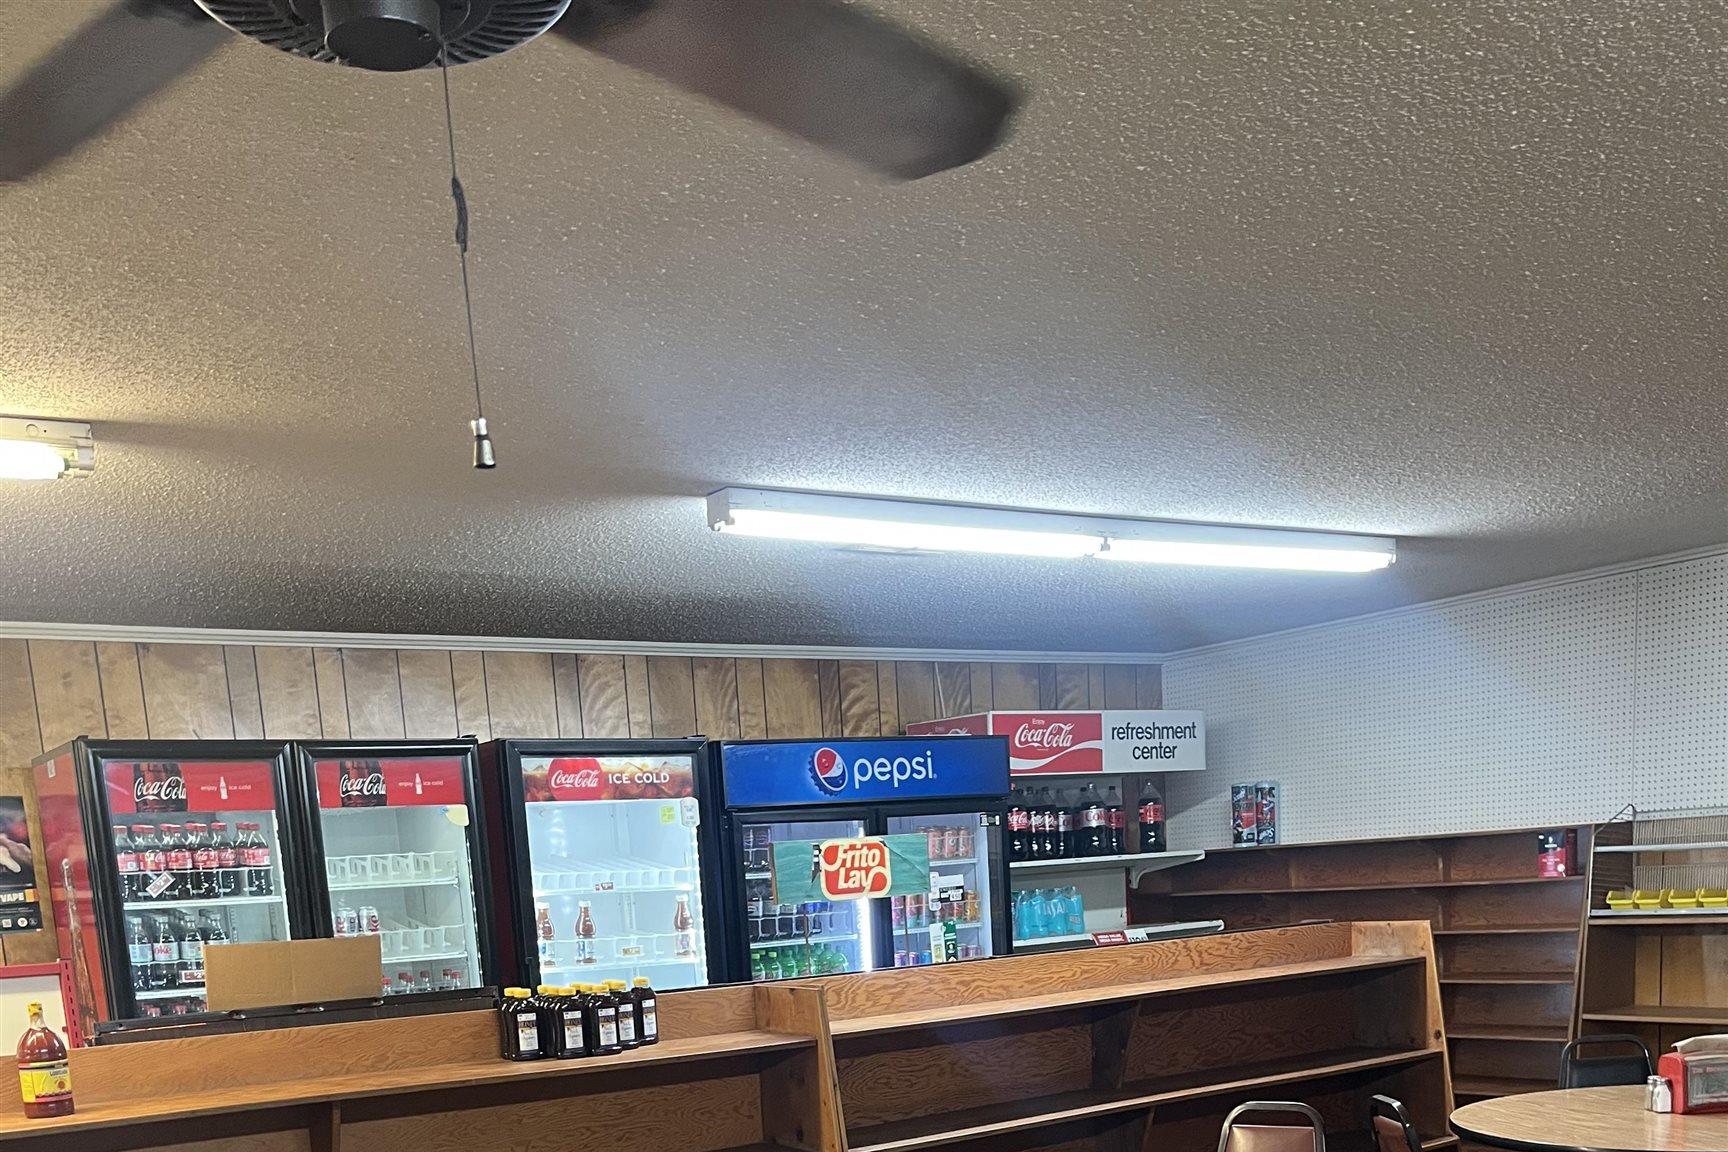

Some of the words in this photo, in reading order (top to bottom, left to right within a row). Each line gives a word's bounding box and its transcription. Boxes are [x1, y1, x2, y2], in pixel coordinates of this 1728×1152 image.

[1015, 723, 1075, 748] Coca-Cola
[1111, 721, 1197, 740] refreshment
[1132, 742, 1177, 760] center
[551, 769, 600, 788] Coca-Cola
[608, 773, 631, 785] ICE
[635, 772, 670, 784] COLD
[853, 750, 934, 789] pepsi
[134, 776, 187, 802] Coca-Cola
[340, 773, 387, 798] Coca-Cola
[835, 841, 882, 869] Frito
[837, 868, 874, 891] Lay
